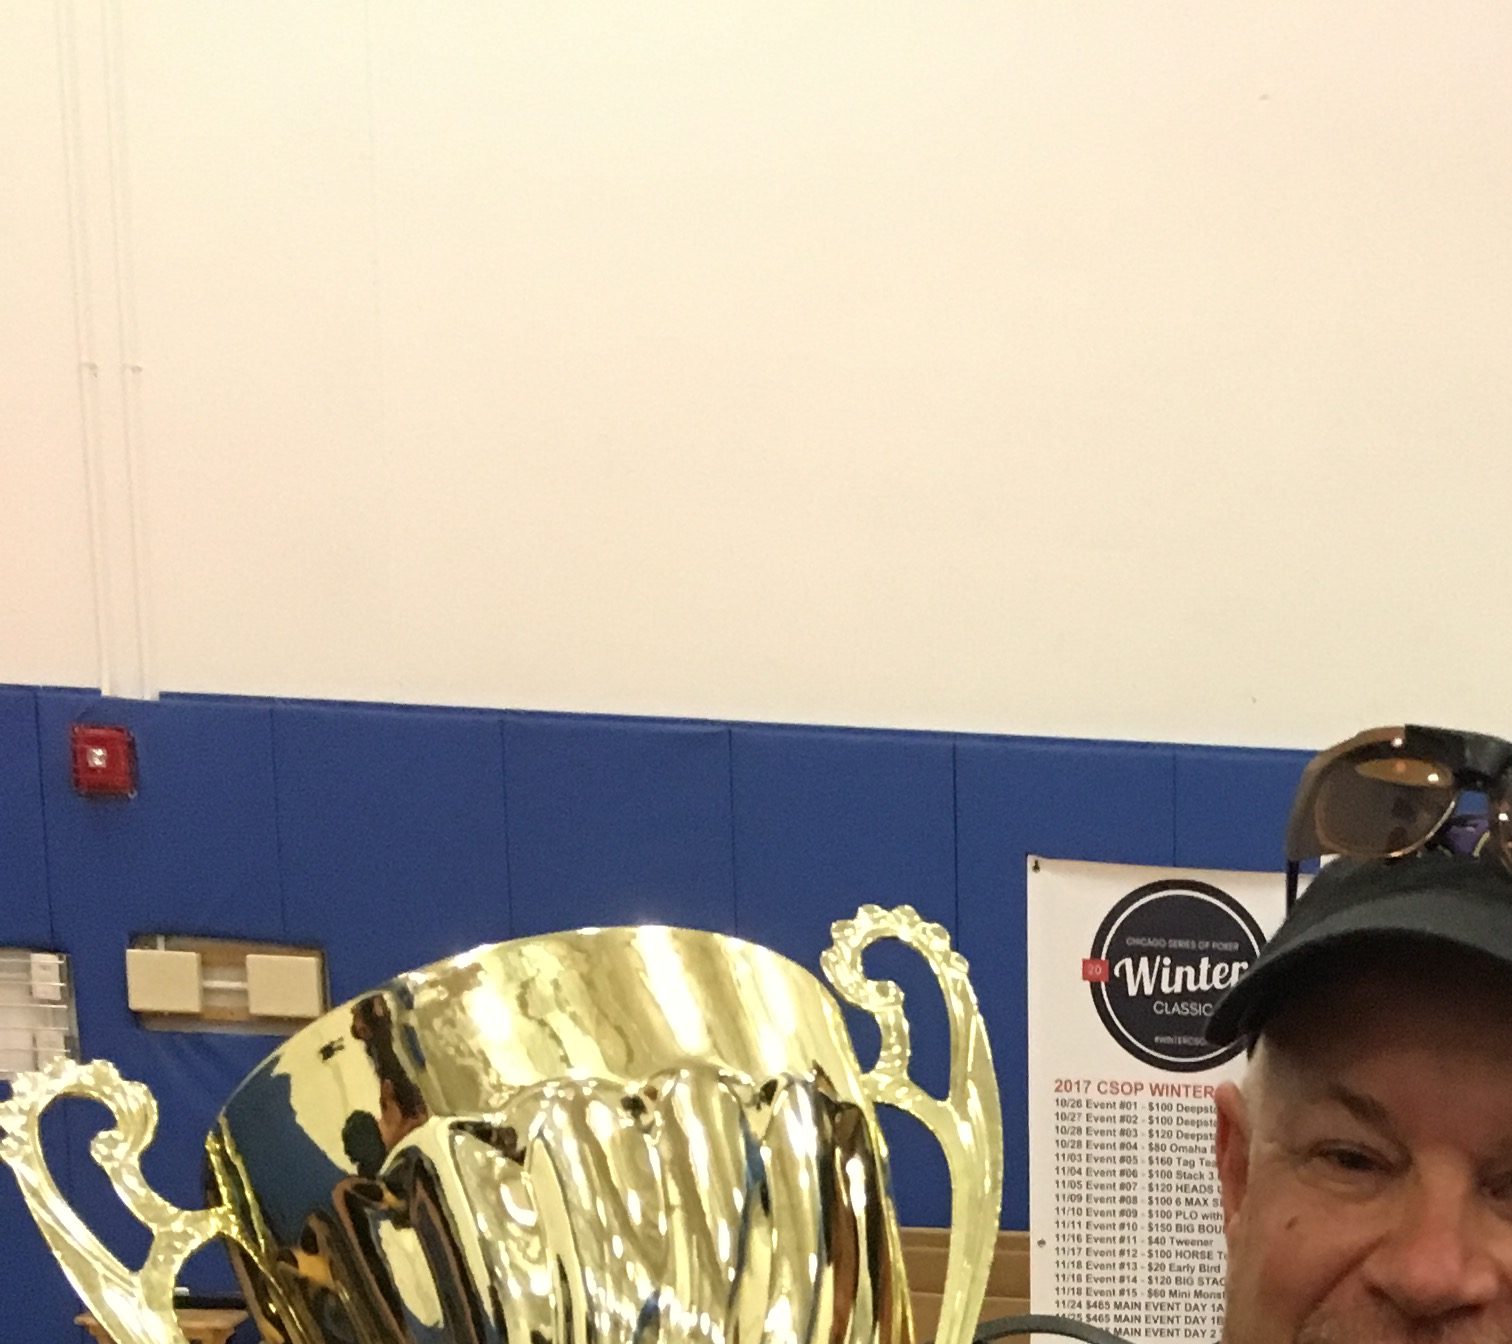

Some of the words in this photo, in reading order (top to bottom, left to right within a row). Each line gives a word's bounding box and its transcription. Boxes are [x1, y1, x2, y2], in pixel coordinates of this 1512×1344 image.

[1198, 940, 1210, 950] OF
[1114, 955, 1248, 997] Winter
[1153, 1001, 1213, 1017] CLASSIC
[1054, 1079, 1091, 1094] 2017
[1097, 1080, 1144, 1096] CSOP
[1150, 1083, 1215, 1099] WINTER
[1085, 1099, 1116, 1109] Event
[1119, 1101, 1138, 1110] #01
[1085, 1113, 1116, 1124] Event
[1119, 1115, 1138, 1124] #02
[1085, 1126, 1116, 1137] Event
[1119, 1128, 1138, 1137] #03
[1085, 1140, 1116, 1150] Event
[1119, 1142, 1138, 1151] #04
[1170, 1143, 1207, 1154] Omaha
[1085, 1153, 1116, 1164] Event
[1119, 1155, 1138, 1164] #05
[1176, 1157, 1195, 1169] Tag
[1085, 1167, 1116, 1177] Event
[1176, 1168, 1205, 1180] Stack
[1208, 1172, 1214, 1180] 3
[1085, 1180, 1116, 1191] Event
[1119, 1182, 1138, 1191] #07
[1175, 1184, 1214, 1194] HEADS
[1085, 1193, 1116, 1204] Event
[1175, 1197, 1182, 1206] 6
[1184, 1197, 1208, 1206] MAX
[1085, 1207, 1116, 1217] Event
[1119, 1209, 1138, 1218] #09
[1175, 1210, 1198, 1220] PLO
[1201, 1212, 1223, 1220] with
[1085, 1221, 1116, 1230] Event
[1119, 1222, 1138, 1231] #10
[1175, 1224, 1195, 1233] BIG
[1198, 1224, 1224, 1234] BOU
[1085, 1234, 1116, 1244] Event
[1119, 1235, 1138, 1244] #11
[1169, 1236, 1213, 1246] Tweener
[1085, 1247, 1116, 1257] Event
[1119, 1249, 1138, 1258] #12
[1175, 1250, 1214, 1260] HORSE
[1085, 1261, 1116, 1270] Event
[1119, 1262, 1138, 1271] #13
[1168, 1263, 1196, 1274] Early
[1198, 1264, 1221, 1273] Bird
[1085, 1274, 1116, 1283] Event
[1119, 1275, 1138, 1284] #14
[1175, 1276, 1195, 1286] BIG
[1085, 1287, 1116, 1297] Event
[1119, 1288, 1138, 1297] #15
[1168, 1289, 1191, 1298] Mini
[1113, 1301, 1142, 1311] MAIN
[1145, 1302, 1181, 1311] EVENT
[1184, 1303, 1207, 1312] DAY
[1211, 1303, 1224, 1312] 1A
[1113, 1314, 1142, 1323] MAIN
[1145, 1315, 1181, 1325] EVENT
[1184, 1315, 1207, 1325] DAY
[1113, 1327, 1142, 1337] MAIN
[1145, 1328, 1181, 1337] EVENT
[1184, 1328, 1207, 1338] DAY
[1210, 1329, 1217, 1338] 2
